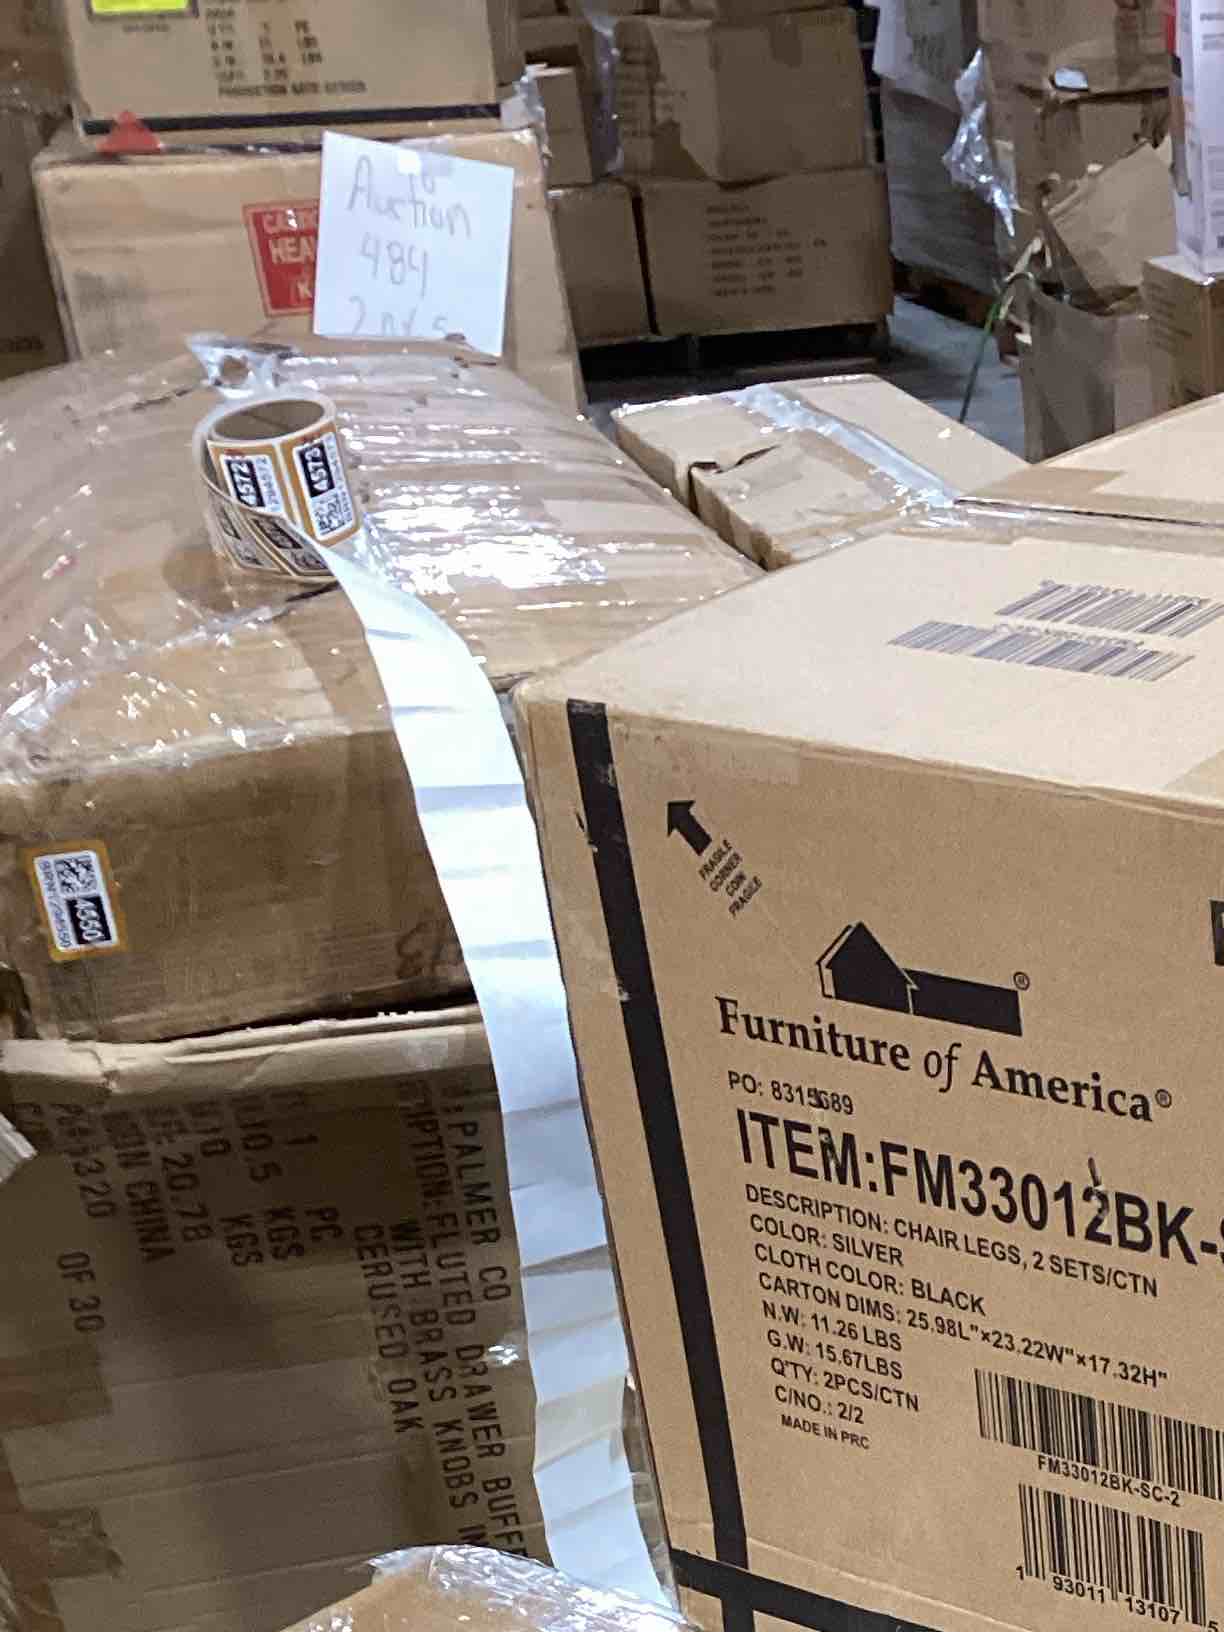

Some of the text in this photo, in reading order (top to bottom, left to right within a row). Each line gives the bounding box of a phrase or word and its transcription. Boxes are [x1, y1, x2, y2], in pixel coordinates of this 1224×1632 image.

[713, 995, 910, 1072] Furniture
[922, 1041, 962, 1094] of
[726, 1069, 763, 1097] PO:
[744, 1182, 1157, 1298] DESCRIPTION: CHAIR LEGS, 2 SETS/CTN
[749, 1212, 904, 1267] COLOR: SILVER
[56, 1251, 106, 1333] OF 30
[478, 1264, 512, 1302] CO
[753, 1241, 986, 1317] CLOTH COLOR: BLACK
[758, 1270, 841, 1309] CARTON
[844, 1291, 901, 1324] DIMS:
[353, 1222, 425, 1435] CERUSED OAK
[810, 1312, 859, 1341] 11.26
[861, 1324, 902, 1352] LBS
[388, 1219, 479, 1509] WITH BRASS KNOBS
[814, 1340, 903, 1380] 15.67LBS
[455, 1343, 507, 1460] DRAWER
[822, 1369, 919, 1412] 2PCS/CTN
[836, 1400, 864, 1425] 2/2
[780, 1412, 869, 1450] MADE IN PRC
[1036, 1453, 1181, 1508] FM33012BK-SC-2
[1014, 1564, 1024, 1581] 1
[1051, 1574, 1105, 1604] 93011
[1123, 1595, 1180, 1625] 13107
